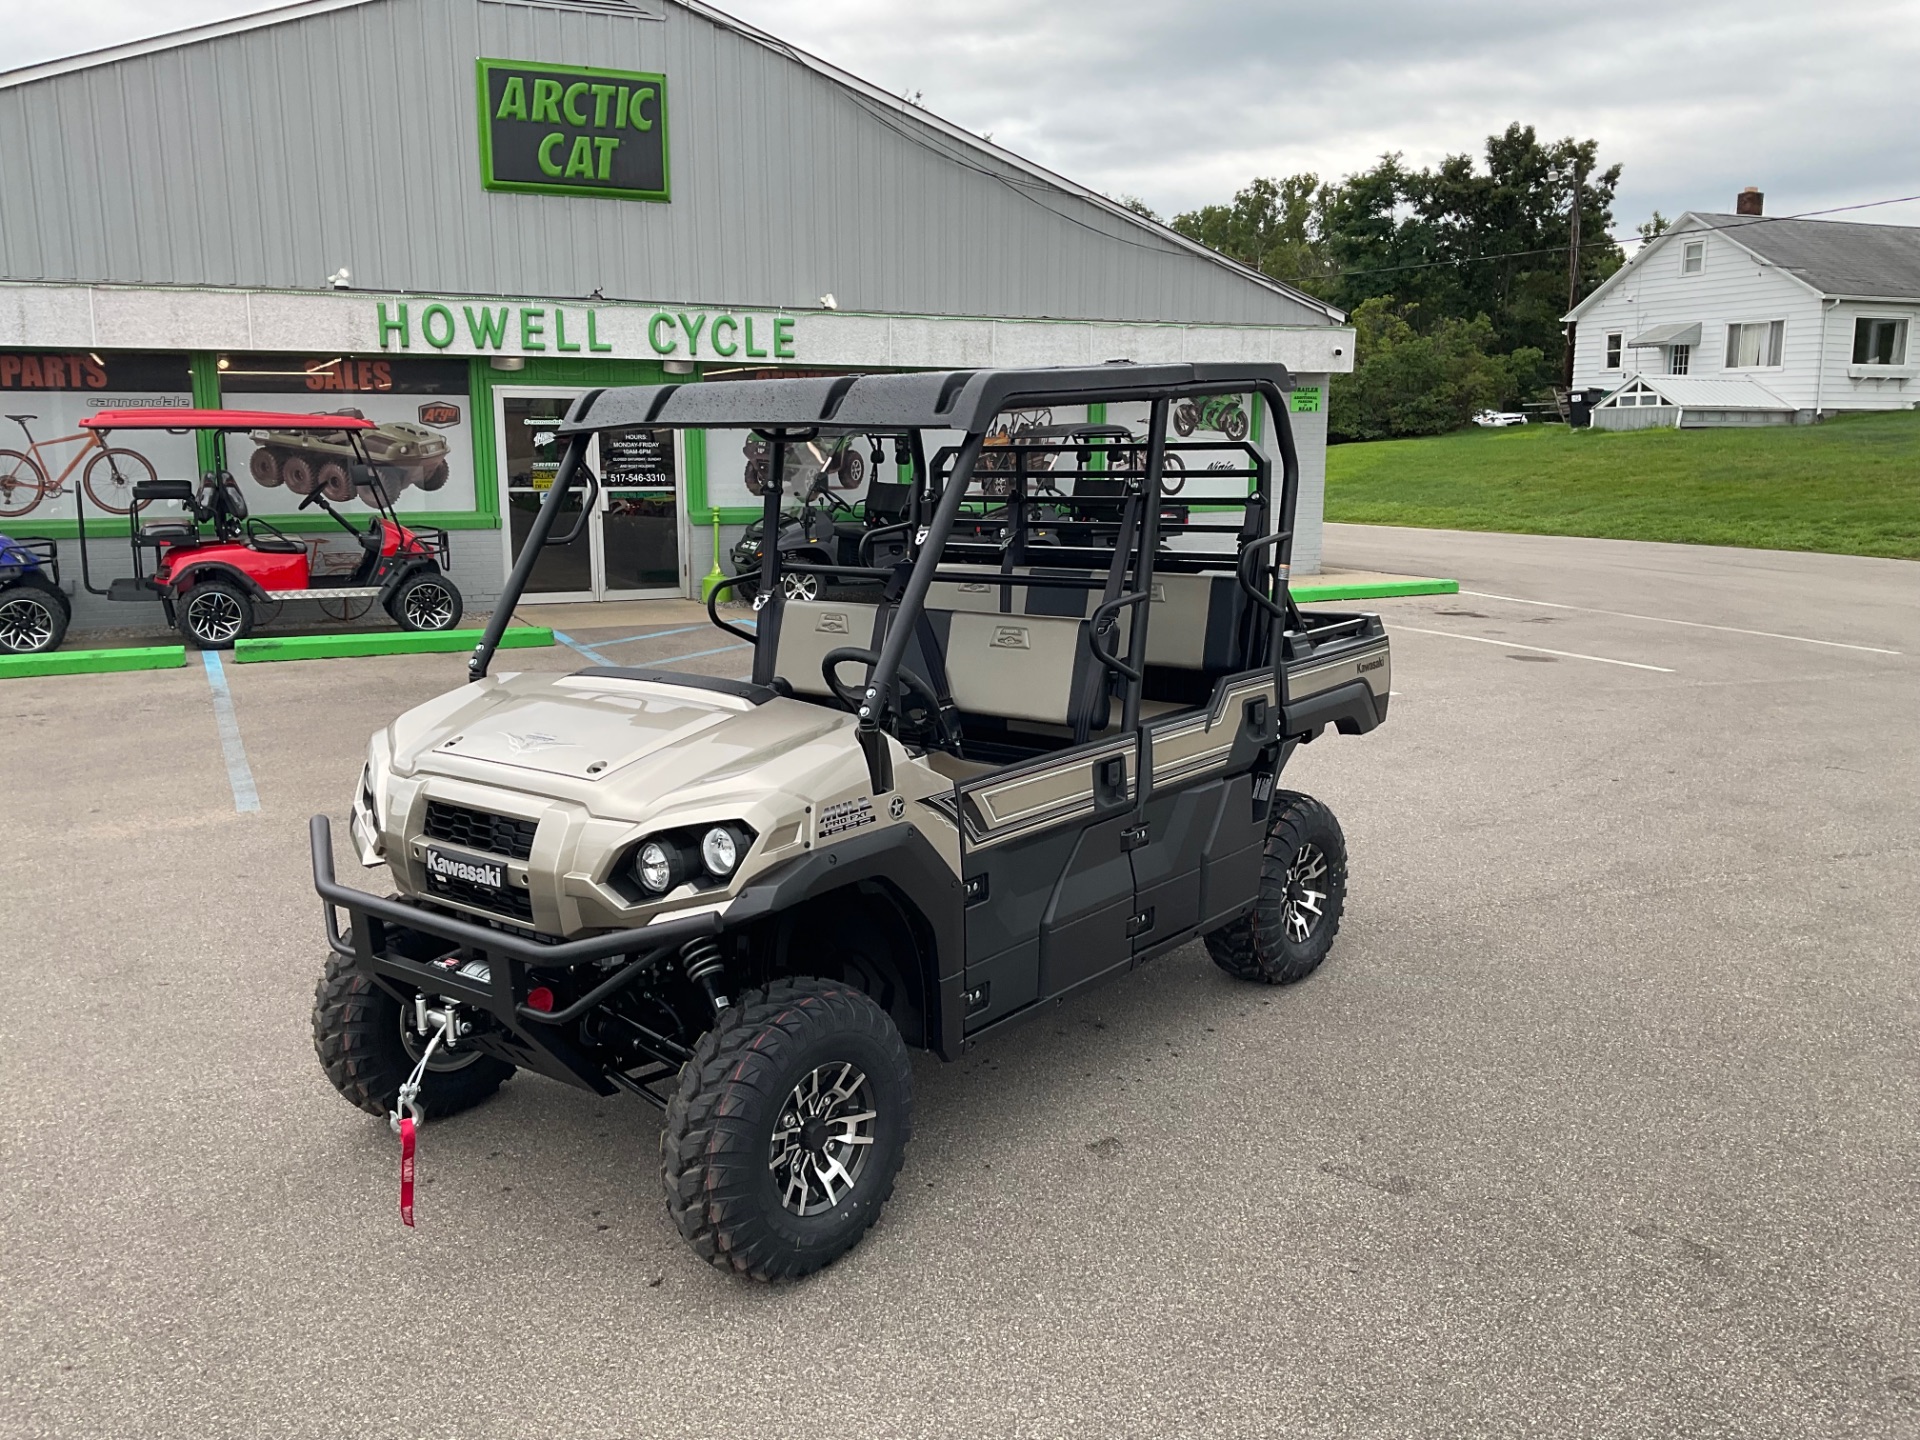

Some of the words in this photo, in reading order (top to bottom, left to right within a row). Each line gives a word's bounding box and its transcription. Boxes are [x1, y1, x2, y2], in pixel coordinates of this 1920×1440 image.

[496, 76, 655, 132] ARCTIC
[538, 132, 620, 181] CAT
[377, 302, 612, 353] HOWELL
[648, 313, 796, 358] CYCLE
[1, 354, 107, 388] PARTS
[304, 360, 392, 391] SALES
[86, 396, 190, 408] cannondale
[423, 407, 457, 422] Argo
[610, 473, 666, 482] 517-546-3310
[1356, 656, 1385, 674] Kawasaki
[819, 796, 873, 824] MULE
[427, 850, 501, 888] Kawasaki
